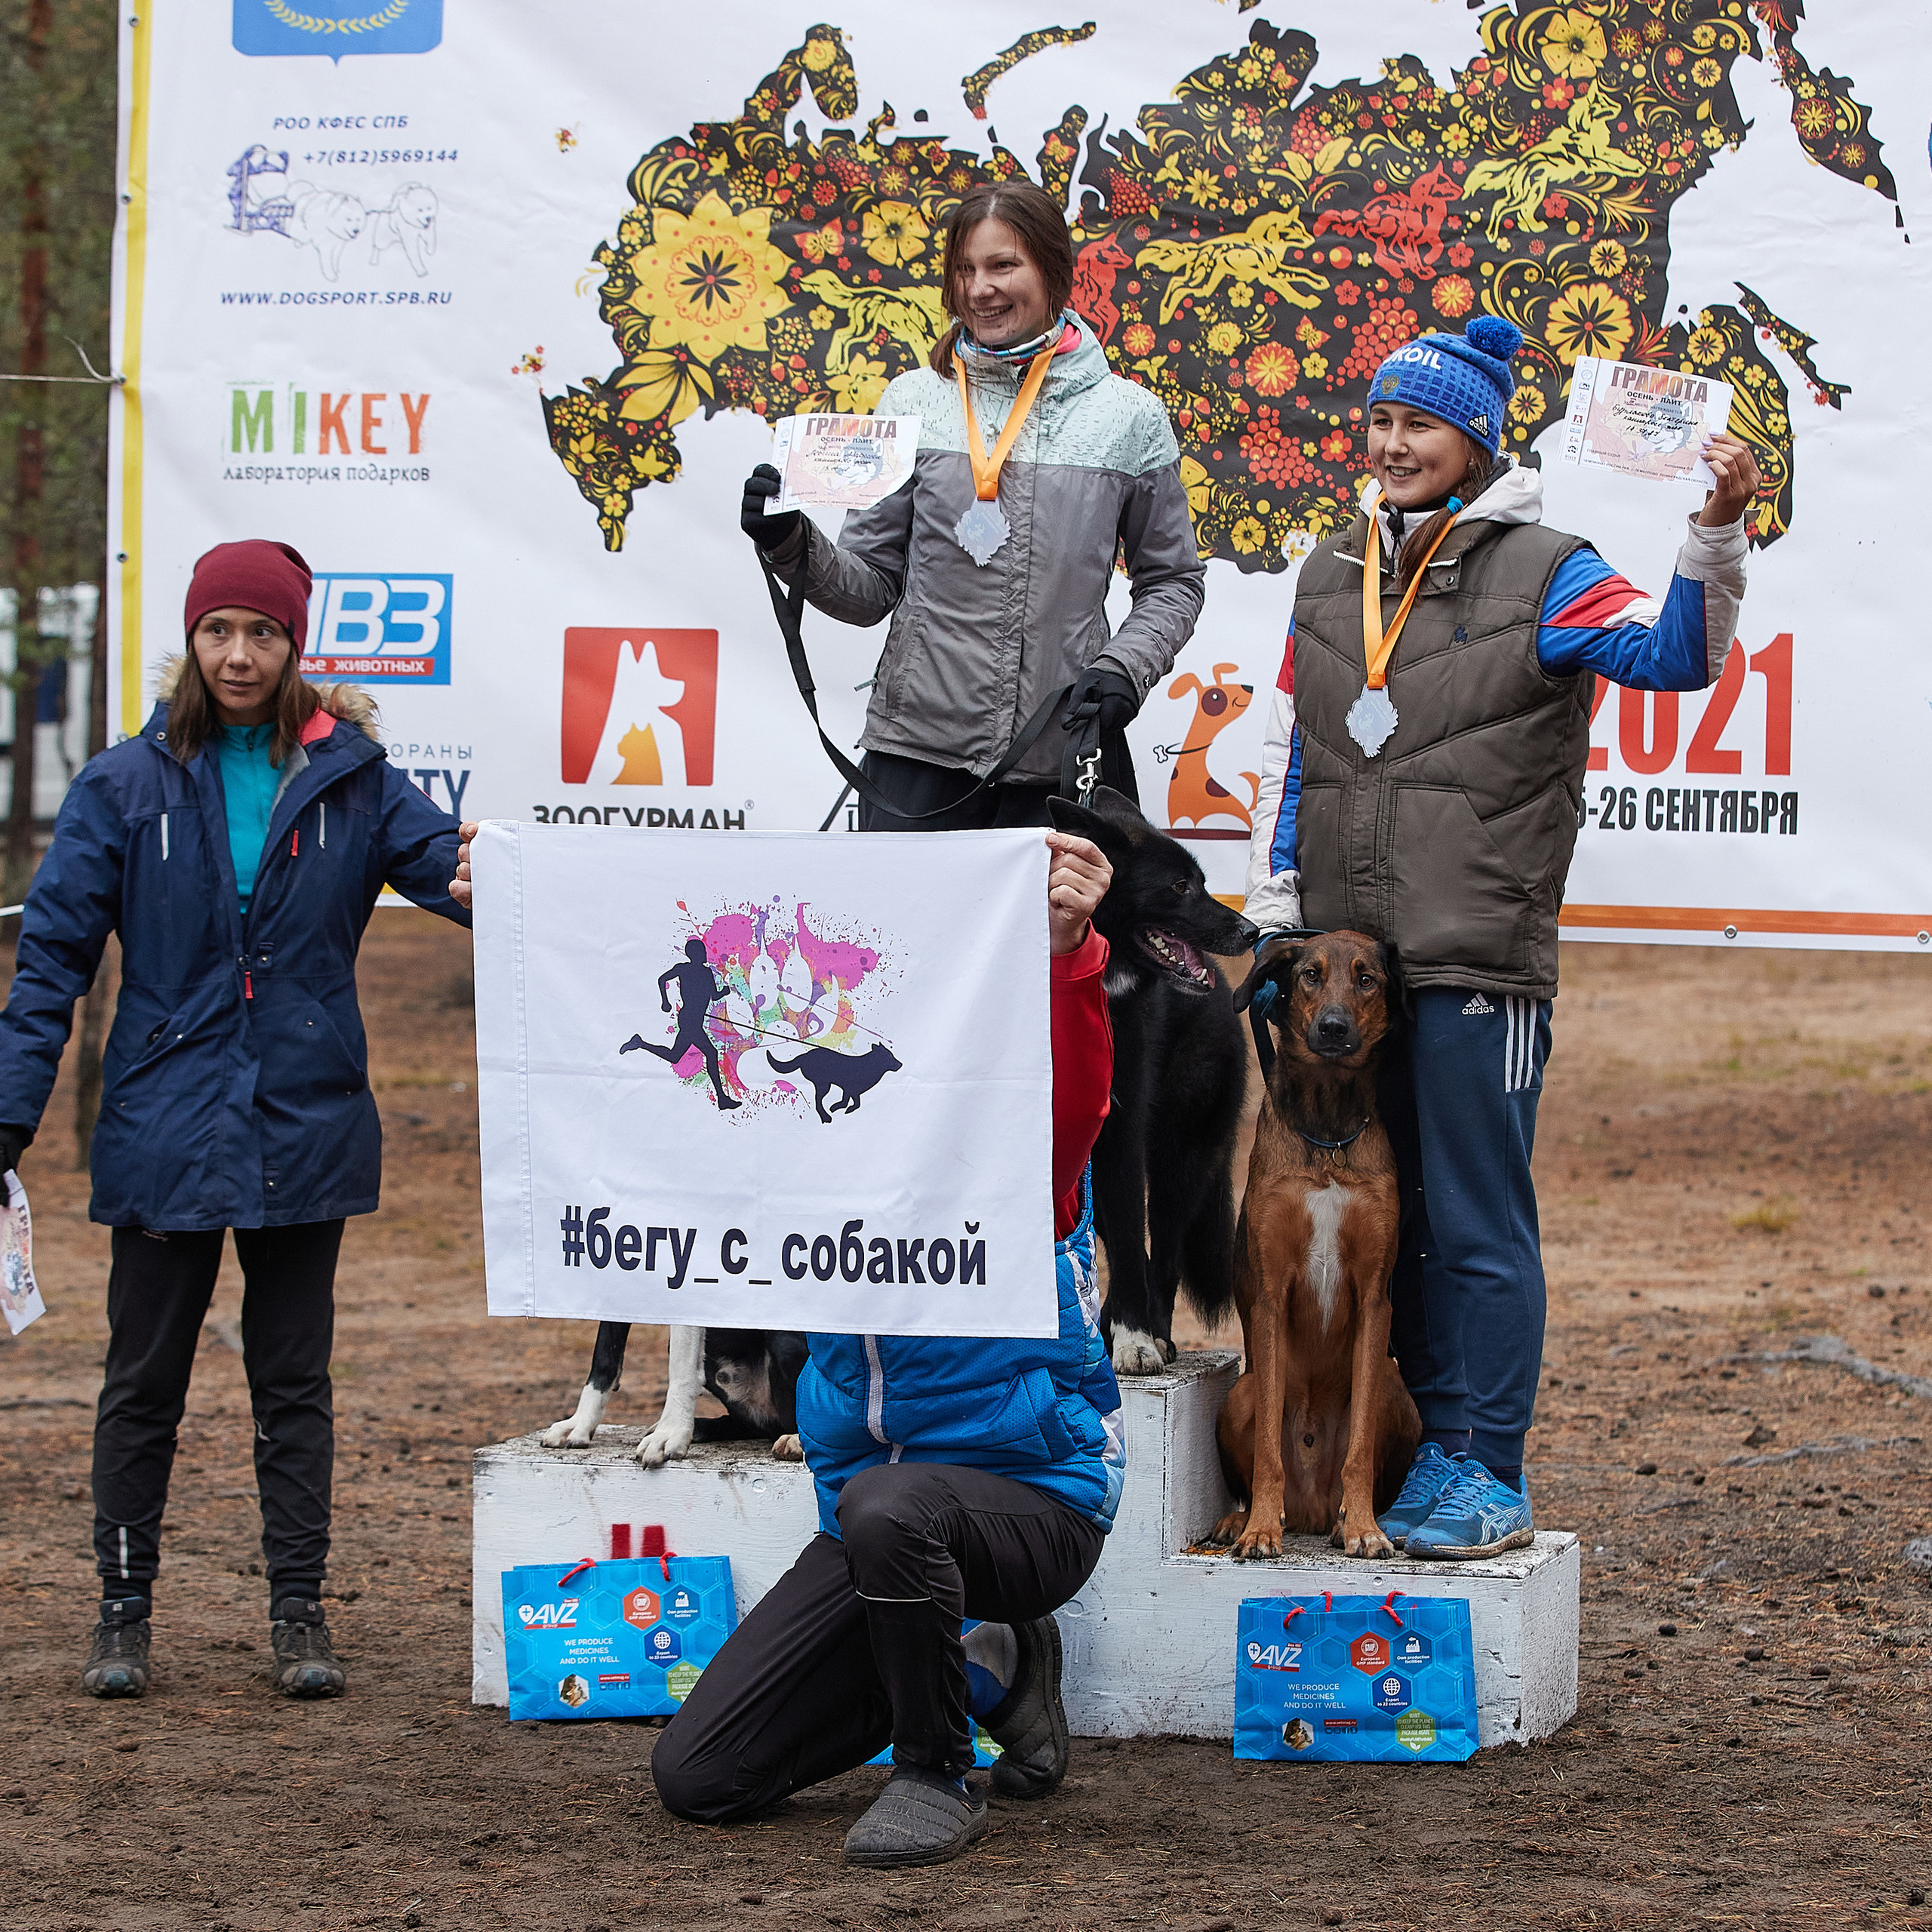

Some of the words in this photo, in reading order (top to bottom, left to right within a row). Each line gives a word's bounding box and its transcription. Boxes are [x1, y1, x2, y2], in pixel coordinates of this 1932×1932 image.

[272, 117, 310, 130] РОО
[317, 116, 367, 129] КФЕС
[372, 115, 410, 128] СПБ
[304, 149, 458, 165] +7(812)5969144
[220, 291, 453, 305] WWW.DOGSPORT.SPB.RU
[1382, 347, 1441, 371] KOIL
[1611, 366, 1708, 403] ГРАМОТА
[1626, 391, 1654, 401] ОСЕНЬ
[230, 388, 432, 455] MIKEY
[805, 417, 897, 438] ГРАМОТА
[223, 466, 340, 485] лаборатория
[346, 463, 431, 485] подарков
[334, 659, 426, 674] животных
[381, 743, 472, 760] ОРАНЫ
[533, 804, 746, 831] ЗООГУРМАН
[1644, 786, 1799, 835] СЕНТЯБРЯ
[1461, 1004, 1495, 1016] adidas
[559, 1204, 987, 1290] #бегу_с_собакой
[528, 1602, 580, 1625] AVZ
[577, 1637, 614, 1646] PRODUCE
[569, 1647, 610, 1655] MEDICINES
[1254, 1644, 1303, 1668] AVZ
[1301, 1683, 1340, 1691] PRODUCE
[1293, 1692, 1335, 1700] MEDICINES
